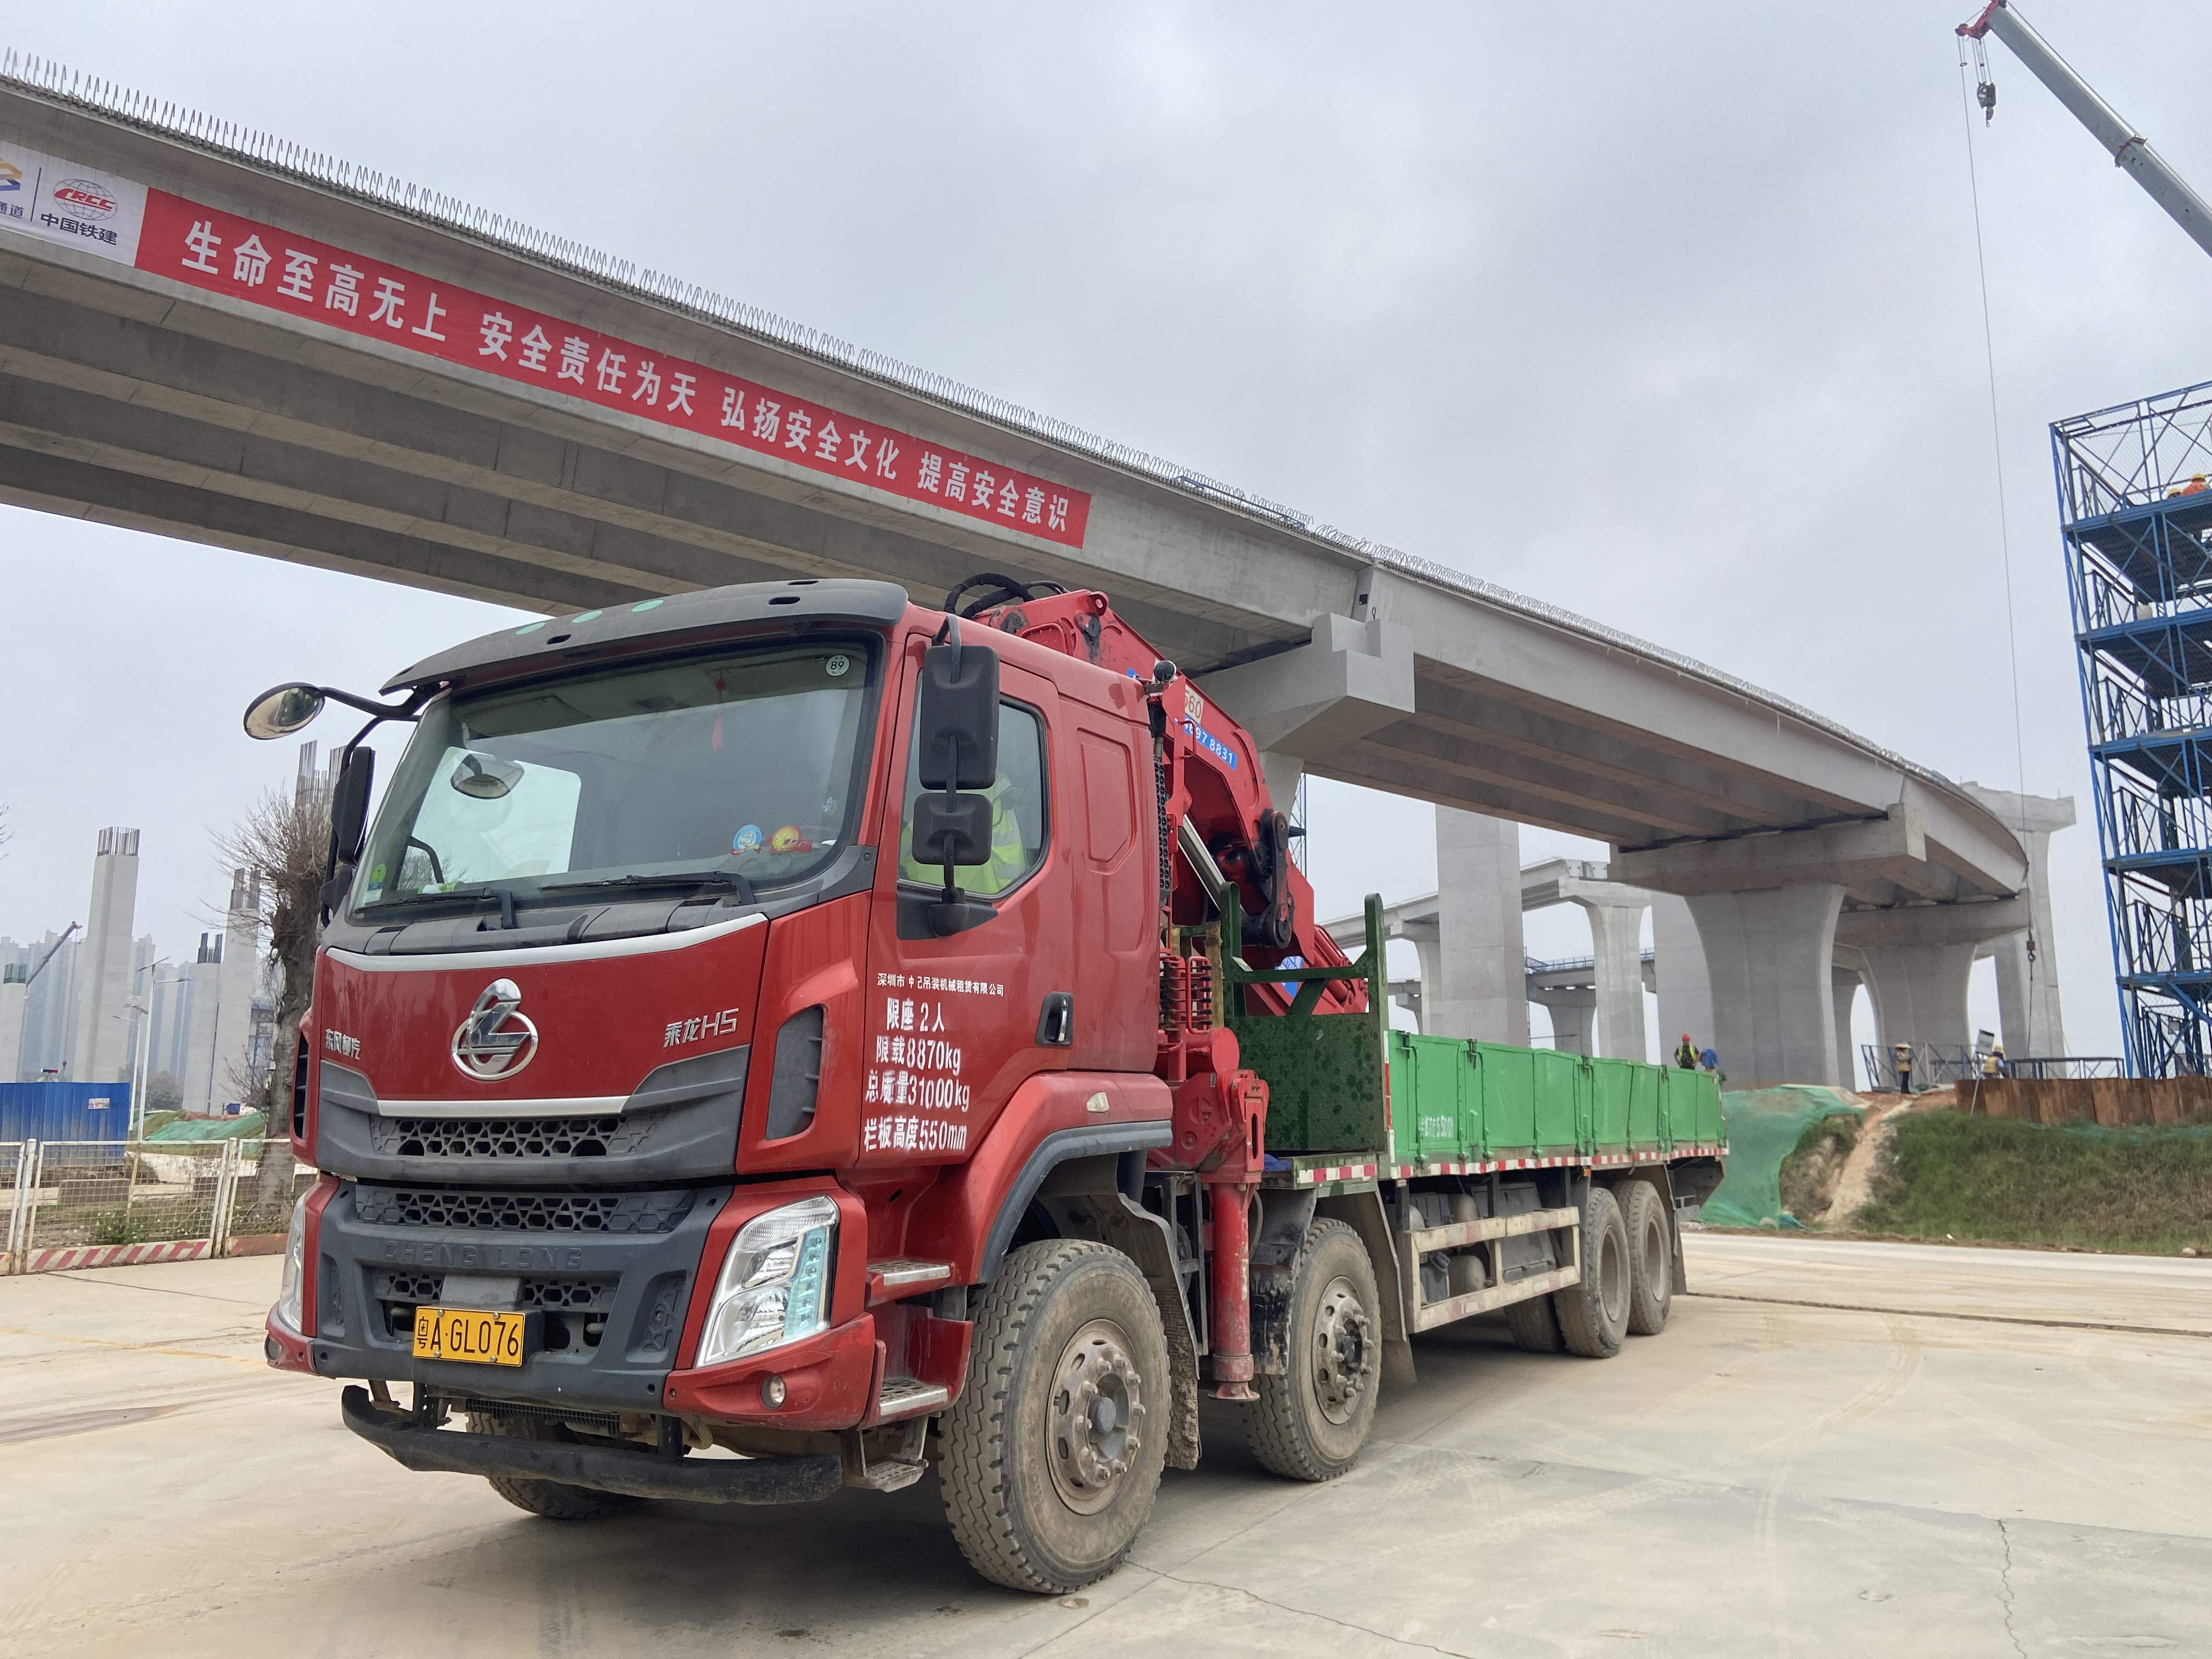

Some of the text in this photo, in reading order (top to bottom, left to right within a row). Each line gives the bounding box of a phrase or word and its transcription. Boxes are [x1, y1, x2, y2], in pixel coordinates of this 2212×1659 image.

[41, 213, 117, 245] 中国铁建
[182, 221, 1069, 532] 生命至高无上 安全责任为天 弘扬安全文化 提高安全意识
[831, 661, 844, 670] 89
[1209, 738, 1233, 764] 8831
[386, 1240, 583, 1269] CHENG LONG
